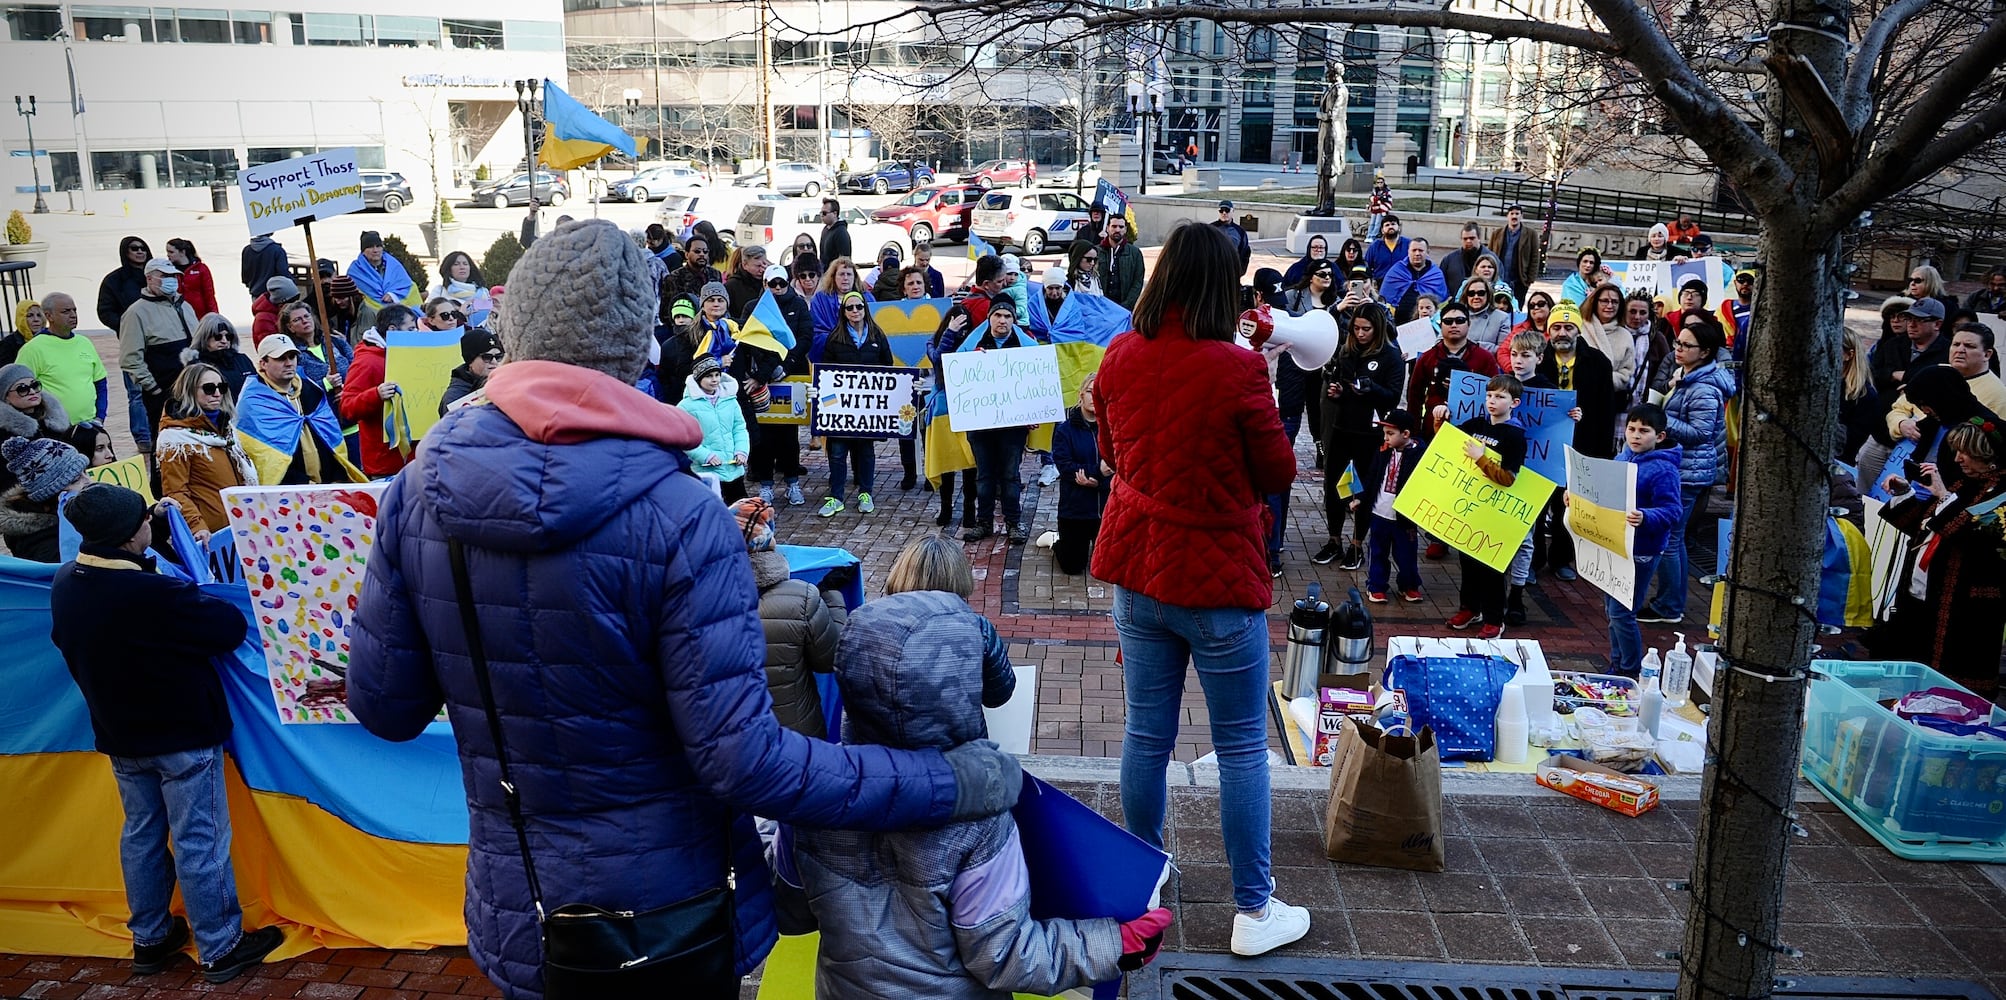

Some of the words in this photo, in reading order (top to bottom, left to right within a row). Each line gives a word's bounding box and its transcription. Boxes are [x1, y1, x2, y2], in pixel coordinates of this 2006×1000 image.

[246, 167, 311, 192] Support
[310, 159, 354, 176] Those
[306, 184, 362, 206] Democracy
[1632, 263, 1657, 271] STOP
[833, 374, 897, 391] STAND
[948, 359, 996, 387] Слава
[840, 393, 888, 409] WITH
[953, 387, 1012, 416] Героям
[1014, 378, 1060, 401] Слава!
[1524, 390, 1558, 408] THE
[819, 413, 899, 430] UKRAINE
[1426, 453, 1453, 479] IS
[1452, 467, 1478, 495] THE
[1476, 484, 1534, 526] CAPITAL
[1454, 498, 1480, 517] OF
[1574, 500, 1598, 524] Home
[1411, 498, 1504, 564] FREEDOM
